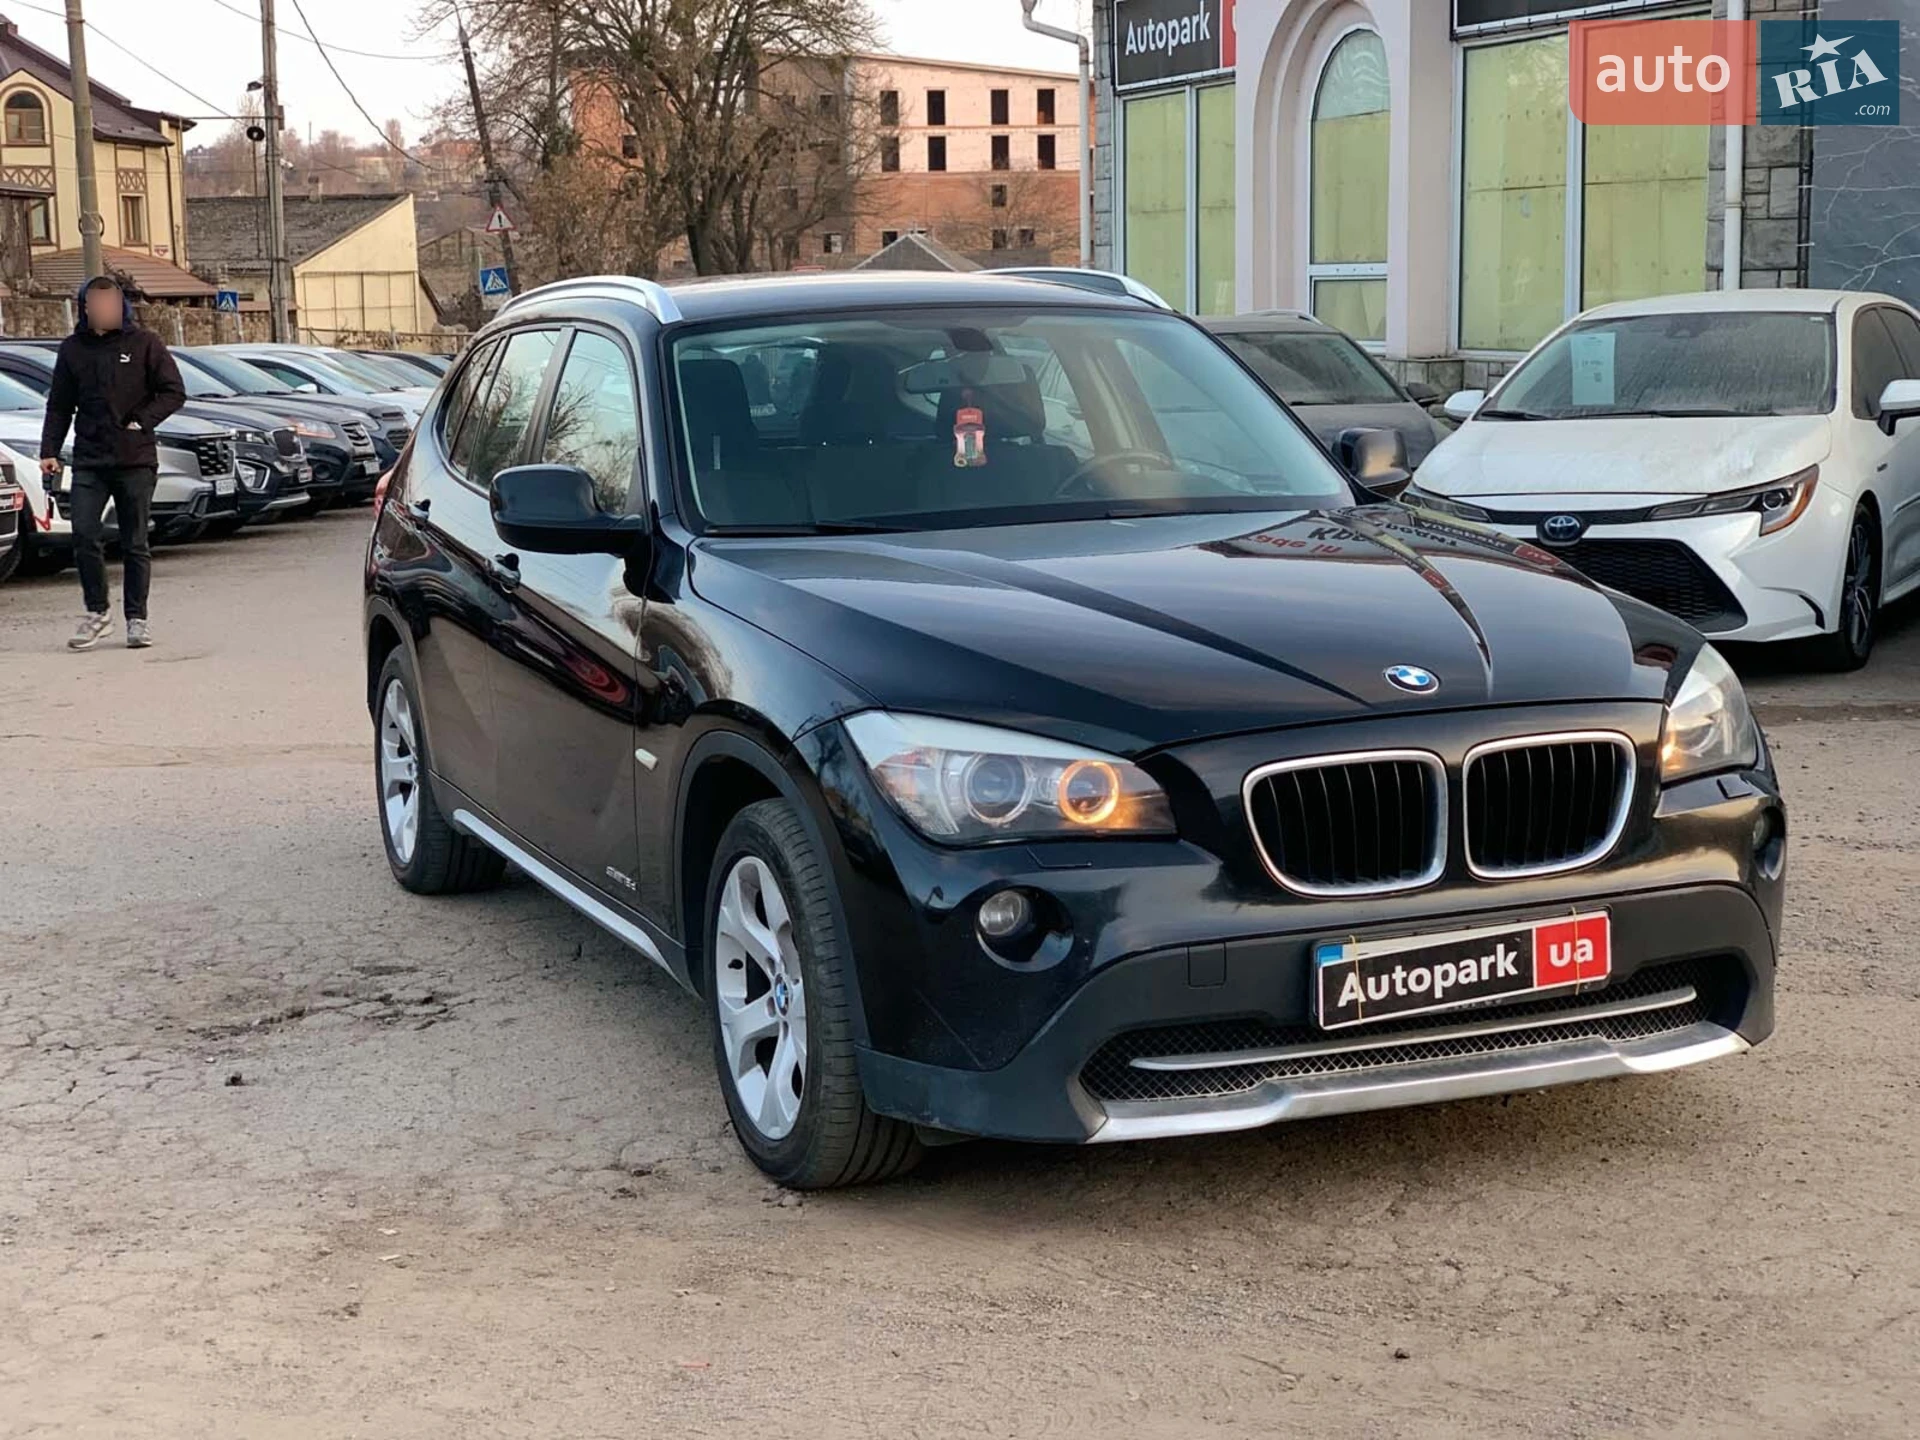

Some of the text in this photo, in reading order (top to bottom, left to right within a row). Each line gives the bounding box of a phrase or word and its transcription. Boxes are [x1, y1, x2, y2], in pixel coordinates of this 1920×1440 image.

[1125, 0, 1211, 56] Autopark
[1337, 937, 1594, 1008] Autopark ua
